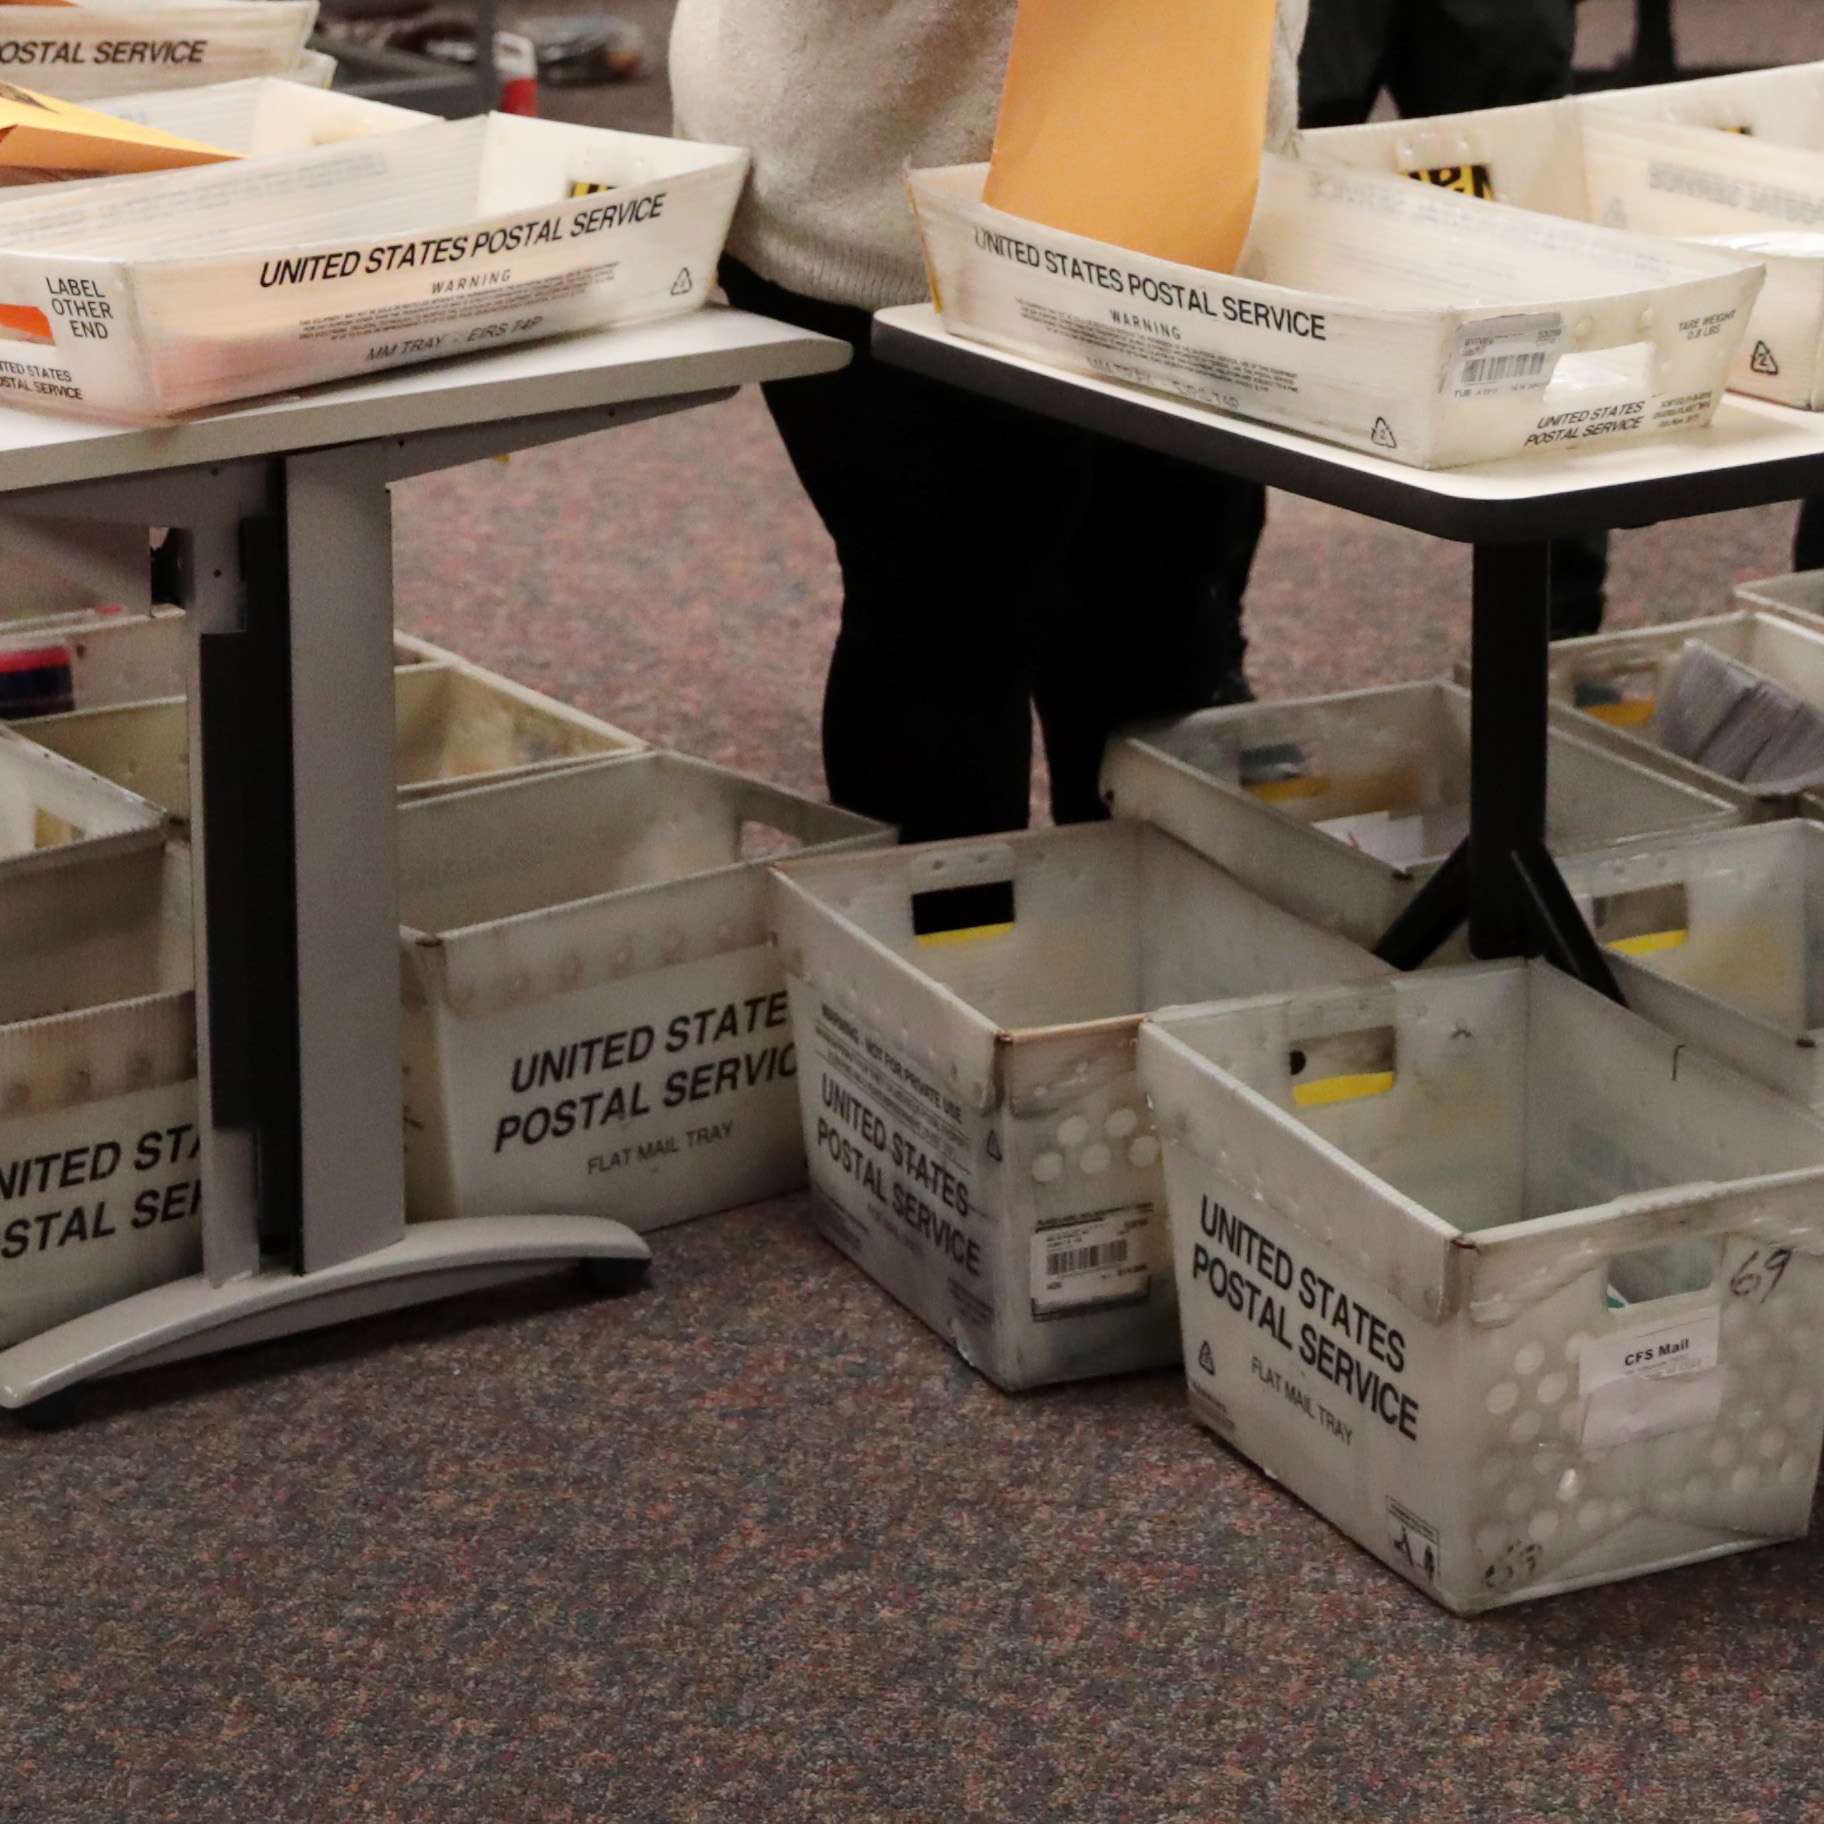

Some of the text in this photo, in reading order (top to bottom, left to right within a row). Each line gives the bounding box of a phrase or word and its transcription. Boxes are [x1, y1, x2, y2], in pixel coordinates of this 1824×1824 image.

[93, 39, 207, 64] SERVICE
[259, 192, 667, 289] UNITED STATES POSTAL SERVICE
[45, 276, 105, 298] LABEL
[431, 268, 513, 296] WARNING
[974, 225, 1328, 341] UNITED STATES POSTAL SERVICE
[51, 298, 114, 319] OTHER
[70, 320, 108, 340] END
[1109, 308, 1183, 340] WARNING
[26, 364, 72, 382] STATES
[34, 380, 84, 400] SERVICE
[1524, 415, 1645, 448] POSTAL SERVICE
[1537, 411, 1589, 430] UNITED
[1590, 401, 1645, 421] STATES
[511, 1025, 654, 1093] UNITED
[664, 990, 788, 1053] STATE
[494, 1082, 650, 1153] POSTAL
[663, 1042, 798, 1108] SERVIC
[588, 1120, 733, 1175] FLAT MAIL TRAY
[822, 1072, 969, 1218] UNITED STATES
[817, 1116, 888, 1204] POSTAL
[891, 1181, 982, 1277] SERVICE
[1200, 1193, 1406, 1373] UNITED STATES
[1729, 1245, 1795, 1304] 69
[1192, 1242, 1293, 1351] POSTAL
[1299, 1323, 1419, 1441] SERVICE
[1624, 1337, 1690, 1366] CFS Mail
[1251, 1355, 1354, 1447] FLAT MAIL TRAY
